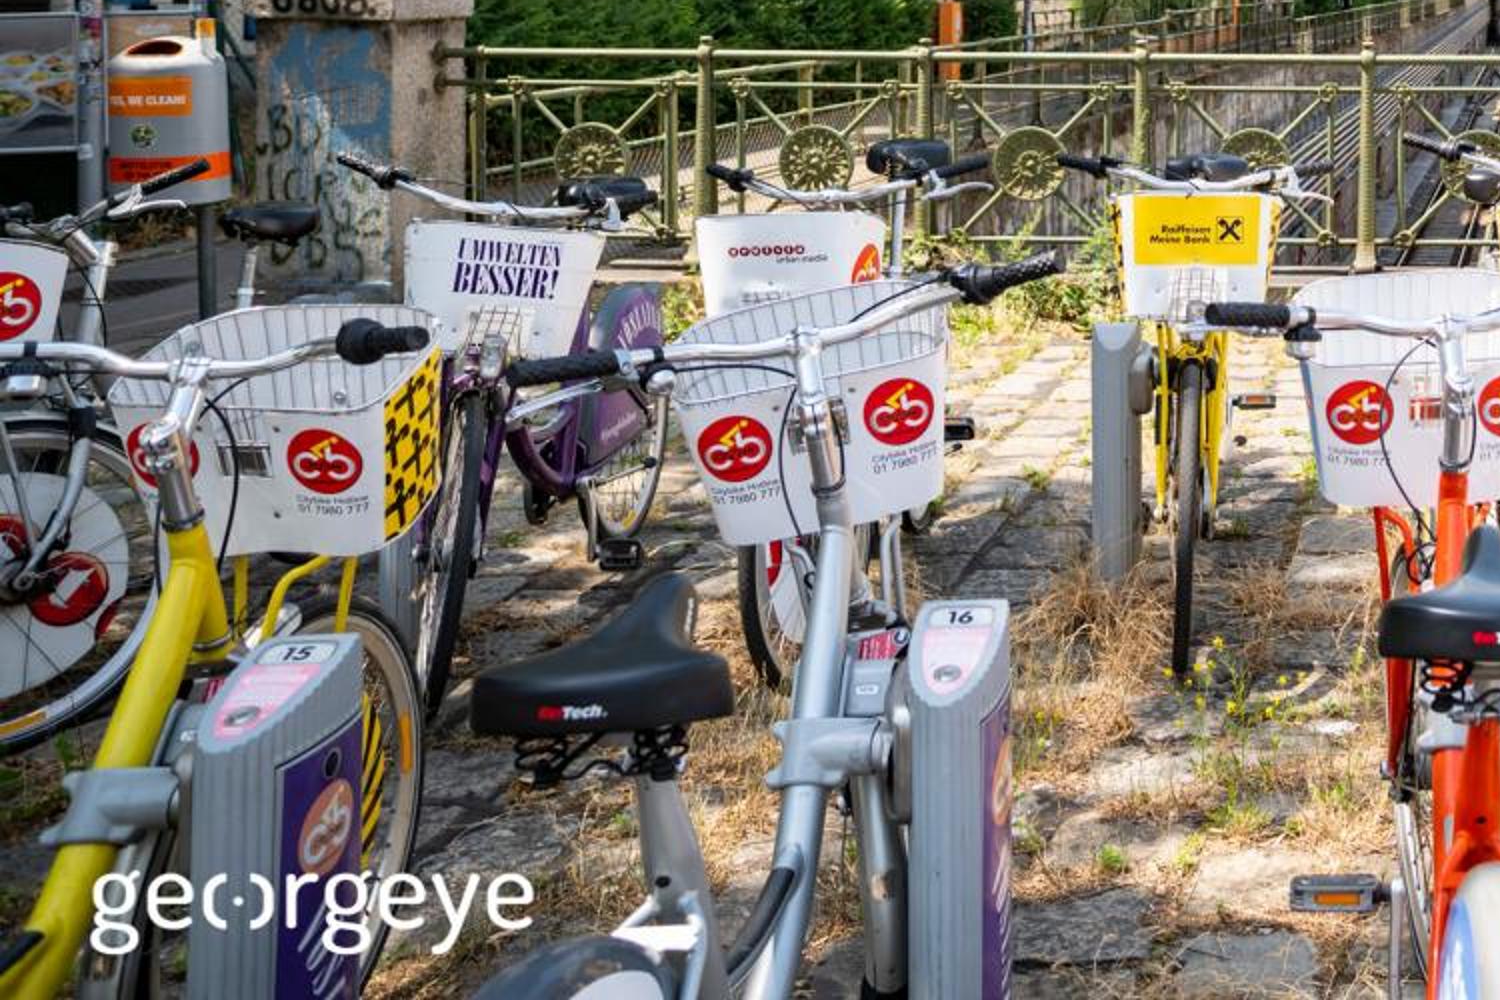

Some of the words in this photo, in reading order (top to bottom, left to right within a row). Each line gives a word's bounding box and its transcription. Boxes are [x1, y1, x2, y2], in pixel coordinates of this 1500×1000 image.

[1184, 235, 1210, 243] Bank
[458, 238, 560, 267] UMWELTEN
[453, 261, 558, 299] BESSER!
[948, 610, 973, 625] 16
[282, 646, 316, 661] 15
